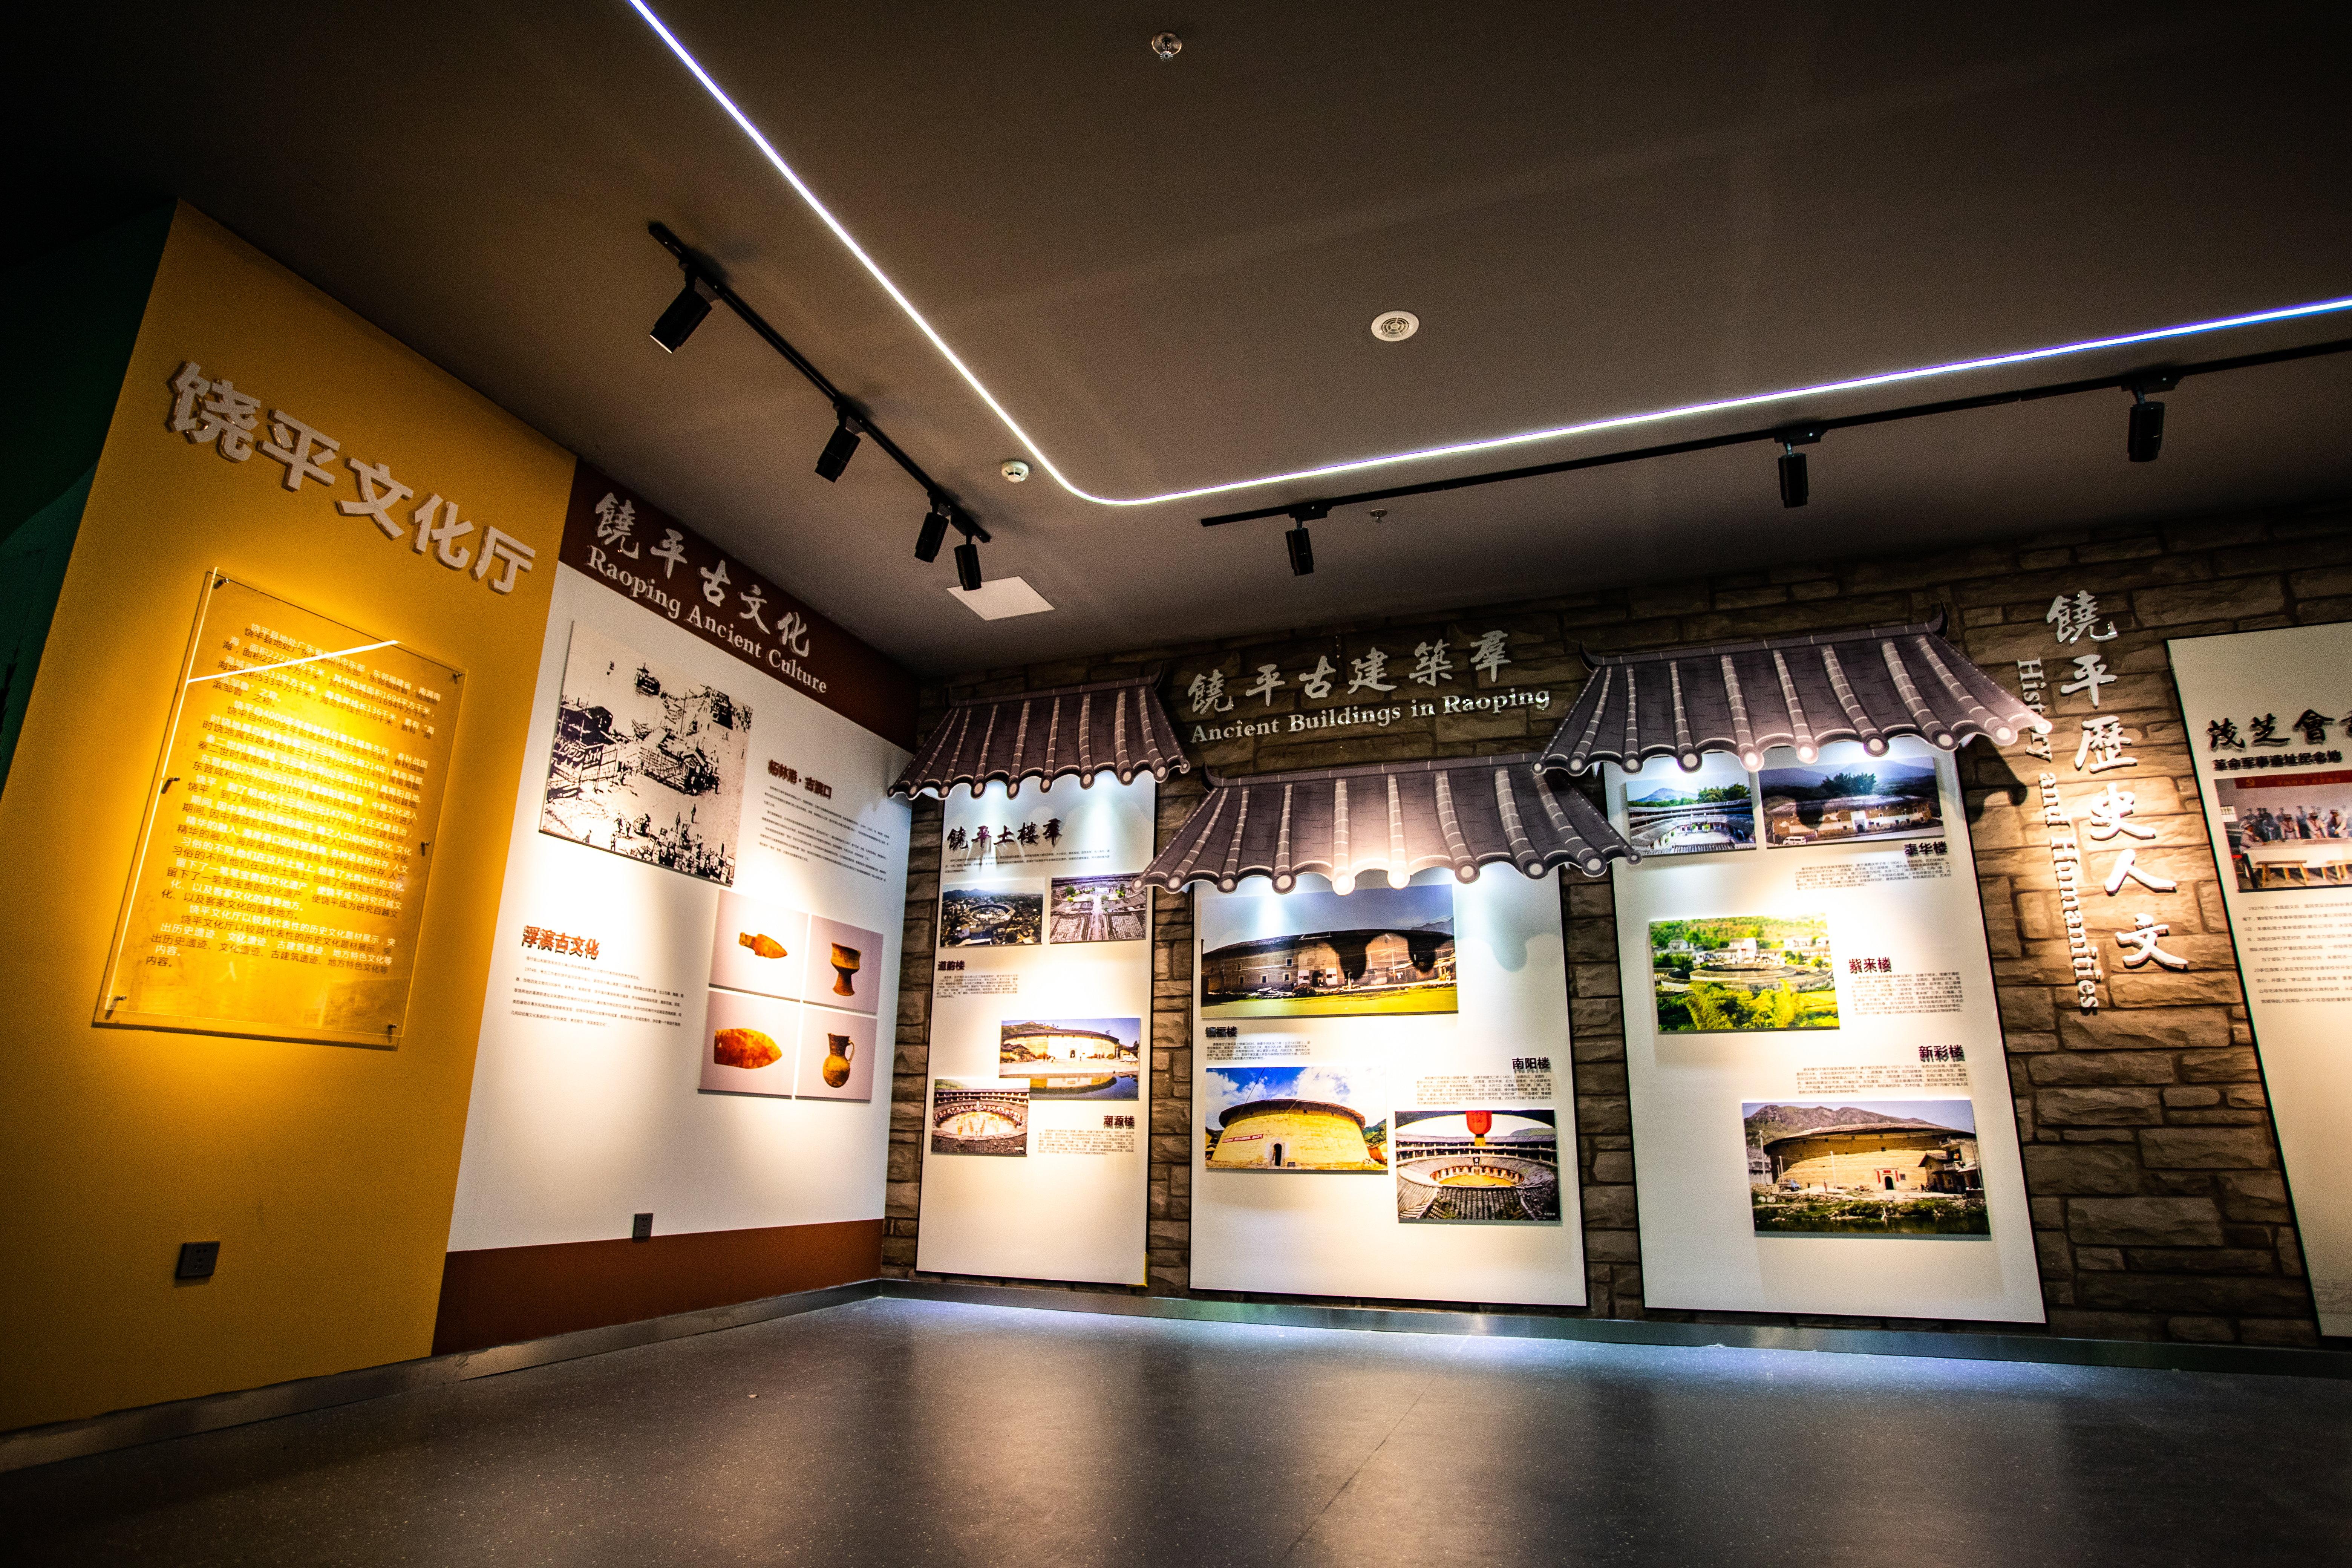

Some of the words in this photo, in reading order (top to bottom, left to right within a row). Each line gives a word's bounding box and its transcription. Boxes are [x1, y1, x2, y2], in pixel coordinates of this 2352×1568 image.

[166, 360, 536, 594] 饶平文化厅
[586, 545, 681, 619] Raoping
[687, 605, 761, 658] Ancient
[768, 649, 827, 693] Culture
[1190, 717, 1280, 744] Ancient
[1288, 703, 1401, 732] Buildings
[1411, 699, 1435, 718] in
[1443, 688, 1550, 714] Raoping
[2017, 657, 2053, 762] Histry
[2213, 750, 2342, 771] 革命军事遗址纪念地
[2039, 772, 2072, 826] and
[1904, 841, 1948, 855] 泰华楼
[2050, 836, 2102, 1010] Humanities
[522, 925, 600, 958] 浮滨古文化
[1849, 957, 1892, 972] 紫来楼
[1512, 1057, 1551, 1070] 南阳楼
[1918, 1044, 1964, 1059] 新彩楼
[1103, 1115, 1135, 1127] 潮源楼
